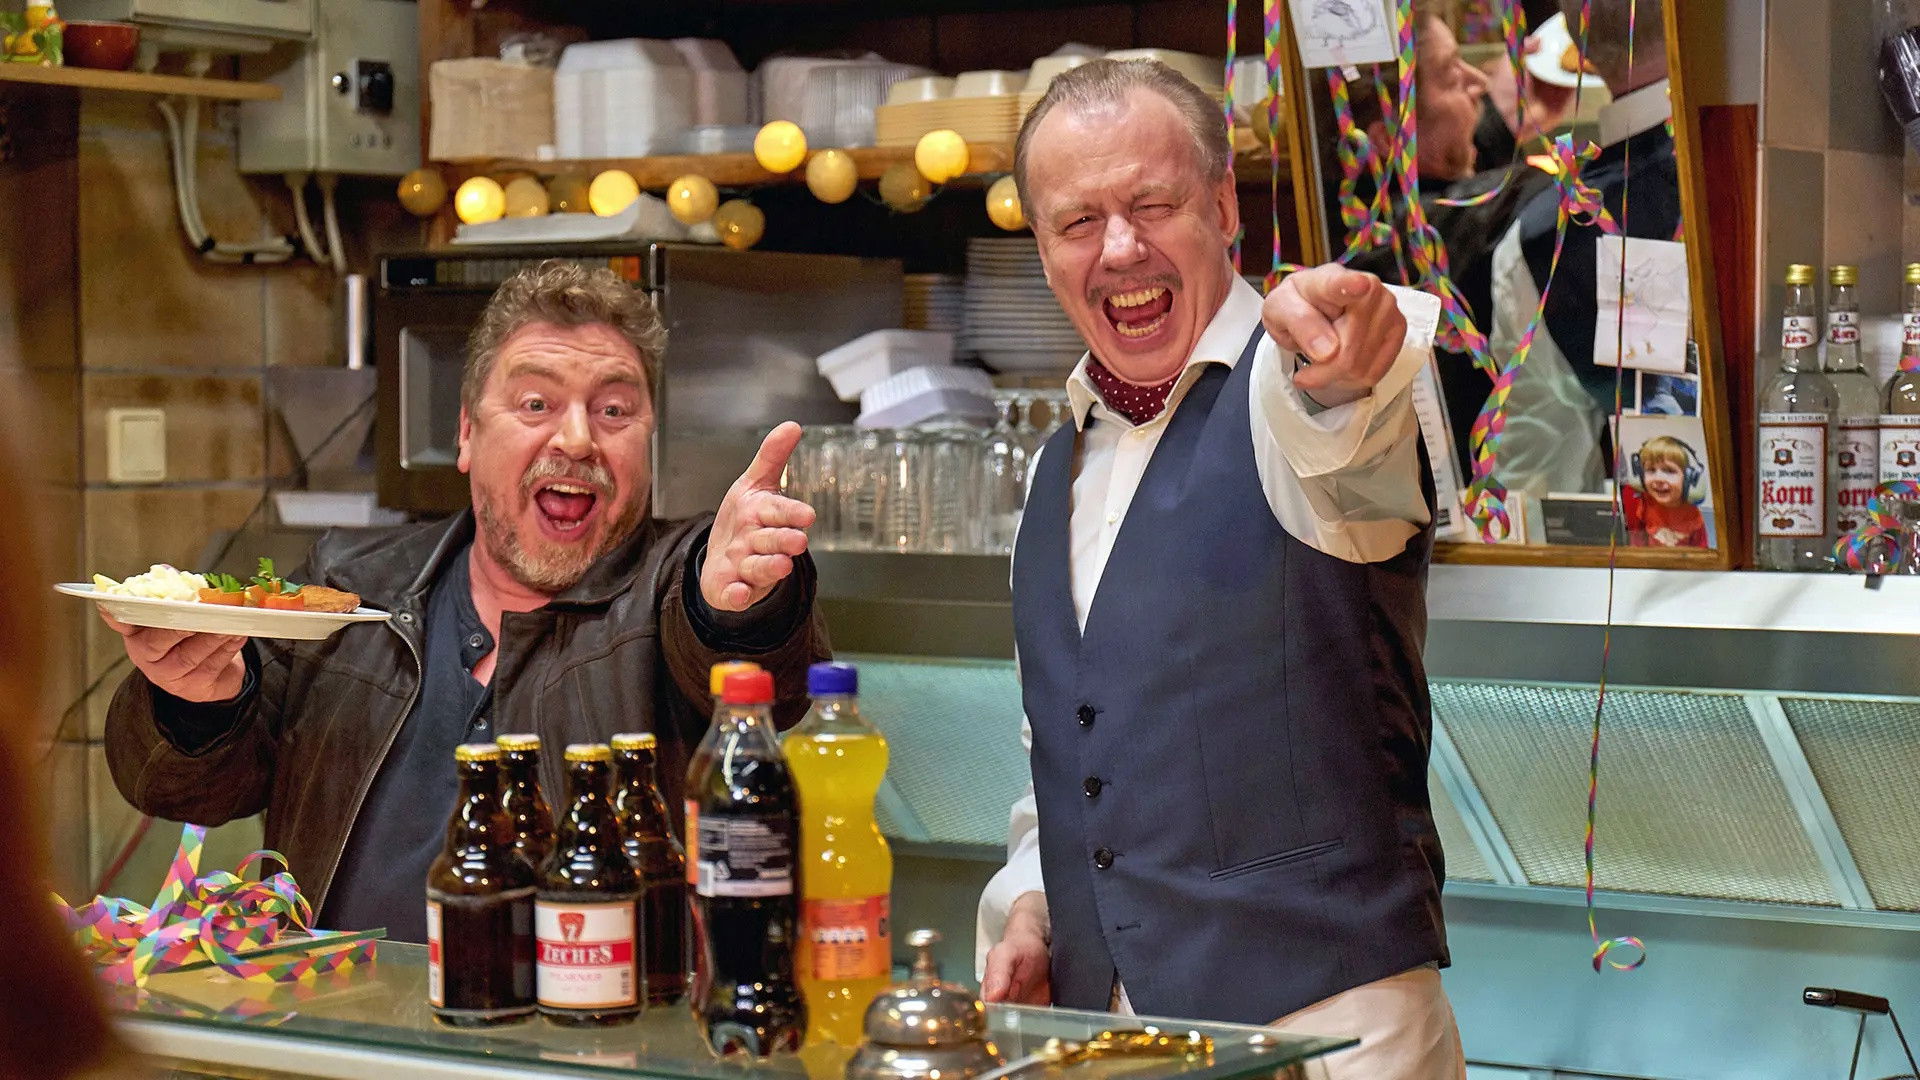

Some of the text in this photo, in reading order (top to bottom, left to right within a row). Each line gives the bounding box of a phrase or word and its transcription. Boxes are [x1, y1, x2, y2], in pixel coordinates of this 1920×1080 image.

[1832, 329, 1857, 339] Korn
[1785, 335, 1807, 344] Korn
[1762, 480, 1814, 505] Korn
